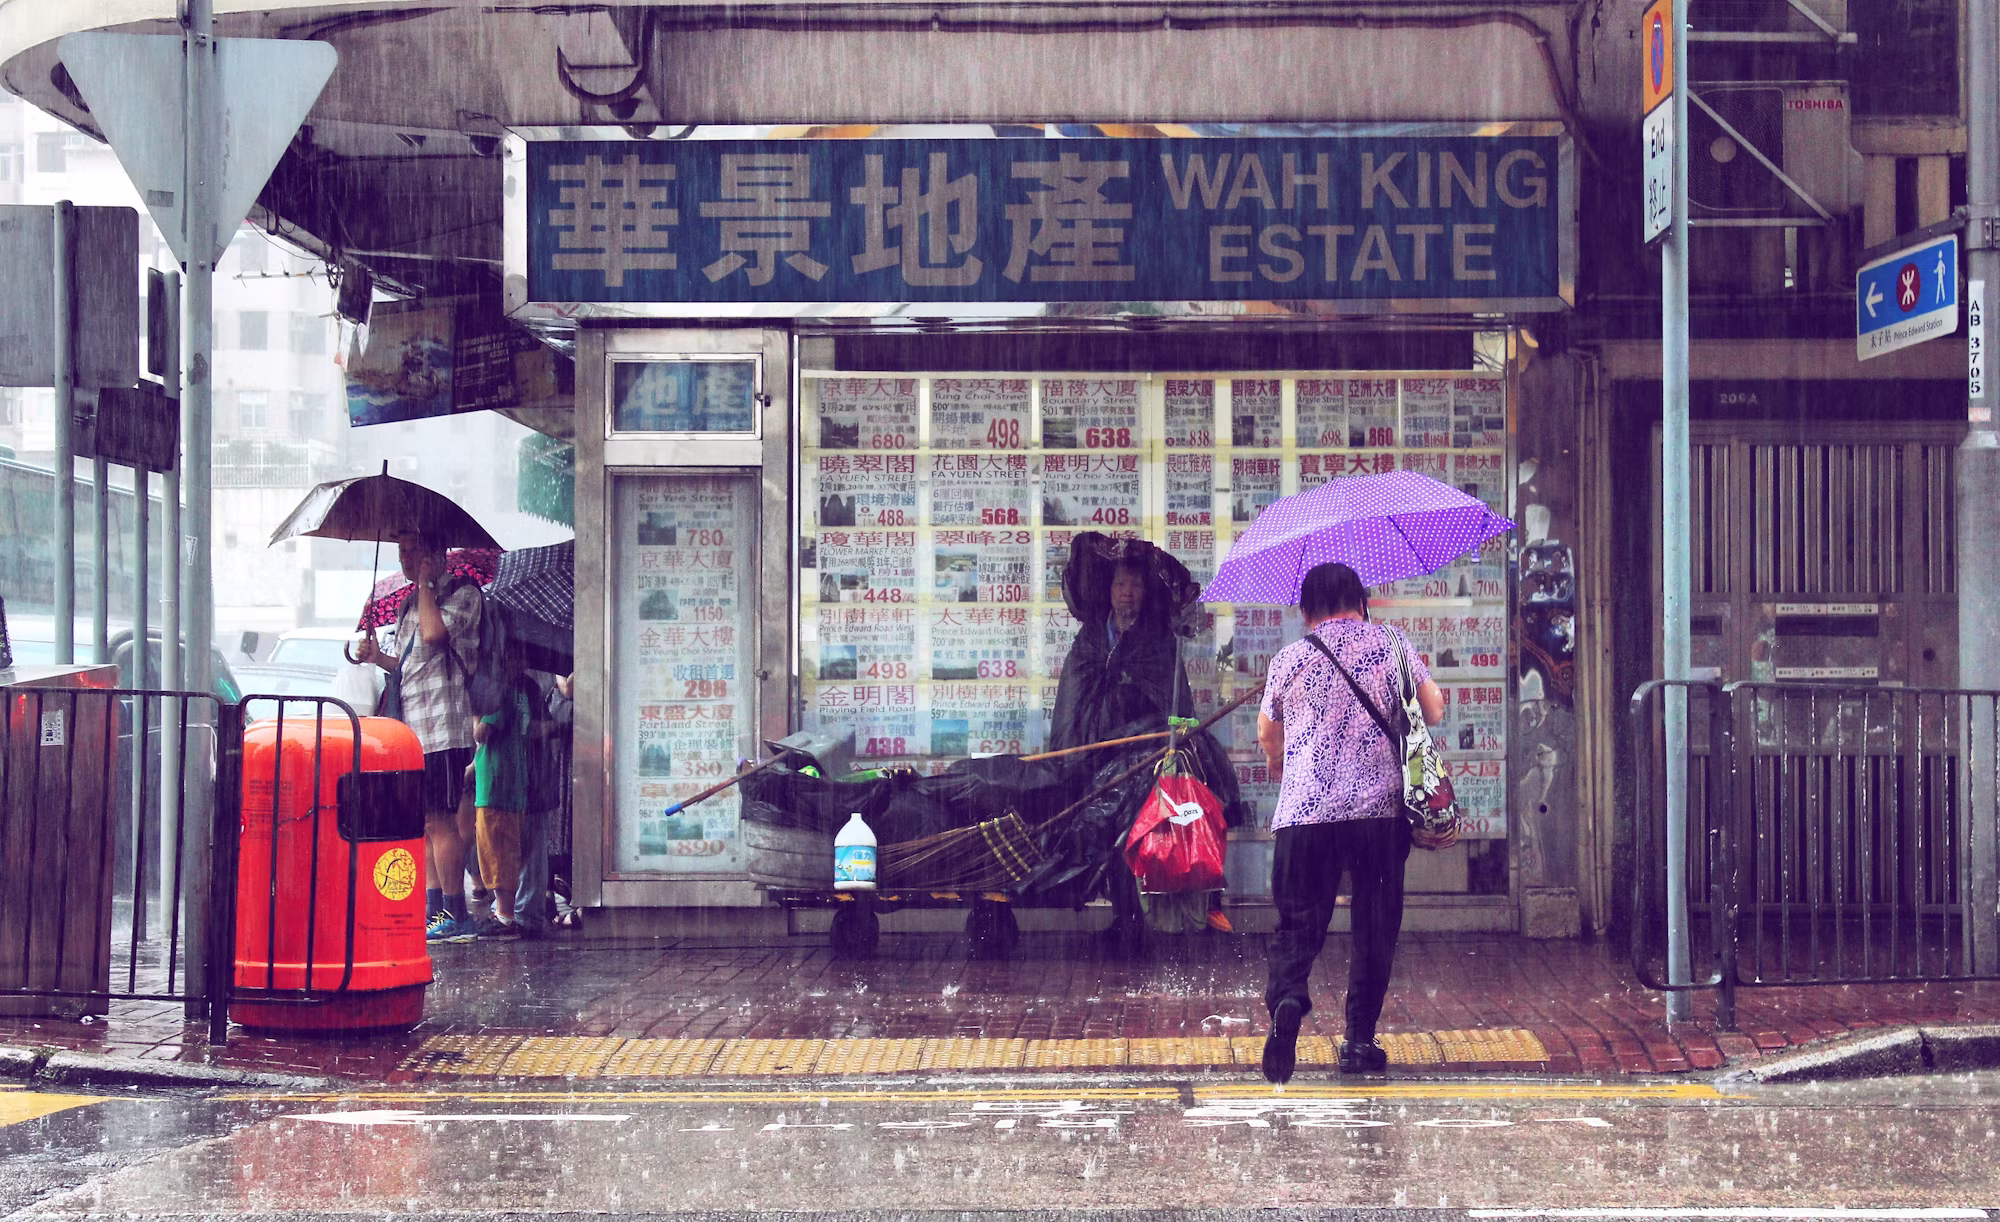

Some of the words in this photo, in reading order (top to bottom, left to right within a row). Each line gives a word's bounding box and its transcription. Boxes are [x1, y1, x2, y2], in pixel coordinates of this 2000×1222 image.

[1787, 99, 1844, 110] TOSHIBA
[1651, 117, 1665, 160] End
[1159, 152, 1330, 209] WAH
[1361, 150, 1548, 209] KING
[548, 153, 1135, 288] 華景地產
[1209, 224, 1497, 283] ESTATE
[1893, 329, 1908, 342] Prince
[1908, 322, 1926, 338] Edward
[1926, 318, 1944, 333] Station
[820, 378, 916, 397] 京華大廈
[1041, 379, 1138, 399] 福祿大廈
[1349, 380, 1396, 397] 亞洲大樓
[935, 393, 960, 401] Tung
[996, 393, 1027, 401] Street
[1041, 397, 1099, 405] Boundary
[1103, 397, 1138, 405] Street
[872, 434, 905, 449] 680
[987, 418, 1019, 448] 498
[1086, 428, 1130, 448] 638
[1190, 430, 1209, 447] 838
[1321, 429, 1341, 446] 698
[1369, 427, 1393, 446] 860
[1043, 454, 1138, 472] 麗明大廈
[639, 494, 658, 503] Sai
[664, 494, 686, 503] Yee
[691, 494, 733, 503] Street
[877, 509, 904, 526] 488
[982, 508, 1018, 525] 568
[1091, 508, 1129, 525] 408
[687, 529, 724, 546] 780
[936, 531, 1031, 546] 翠峰28
[1168, 531, 1213, 549] 富匯居
[639, 550, 735, 569] 京華大廈
[820, 547, 853, 556] FLOWER
[855, 547, 887, 556] MARKET
[891, 547, 915, 556] ROAD
[864, 588, 902, 603] 448
[1425, 580, 1447, 597] 620
[1477, 580, 1498, 597] 700
[694, 606, 723, 622] 1150
[820, 608, 915, 624] 別樹華軒
[933, 608, 1027, 626] 太華樓
[640, 626, 735, 648] 金華大樓
[820, 624, 841, 633] Prince
[845, 624, 872, 633] Edward
[875, 624, 893, 633] Road
[896, 624, 915, 633] West
[931, 627, 957, 636] Prince
[960, 627, 991, 636] Edward
[994, 627, 1015, 636] Road
[1018, 627, 1028, 636] W
[978, 660, 1017, 678] 638
[1187, 658, 1210, 676] 680
[1471, 654, 1499, 667] 498
[867, 661, 907, 679] 498
[684, 680, 728, 698] 298
[820, 685, 915, 707] 金明閣
[932, 684, 1027, 701] 別樹華軒
[820, 706, 857, 714] Playing
[861, 706, 884, 714] Field
[889, 706, 915, 714] Road
[931, 700, 956, 708] Prince
[960, 700, 990, 708] Edward
[993, 700, 1014, 708] Road
[1017, 700, 1027, 708] W
[639, 720, 691, 730] Portland
[695, 720, 733, 730] Street
[968, 730, 997, 739] CLUB
[1002, 730, 1025, 739] HSE
[865, 737, 906, 756] 438
[1480, 736, 1498, 751] 438
[683, 761, 723, 777] 380
[1462, 777, 1501, 785] Street
[678, 840, 726, 856] 890
